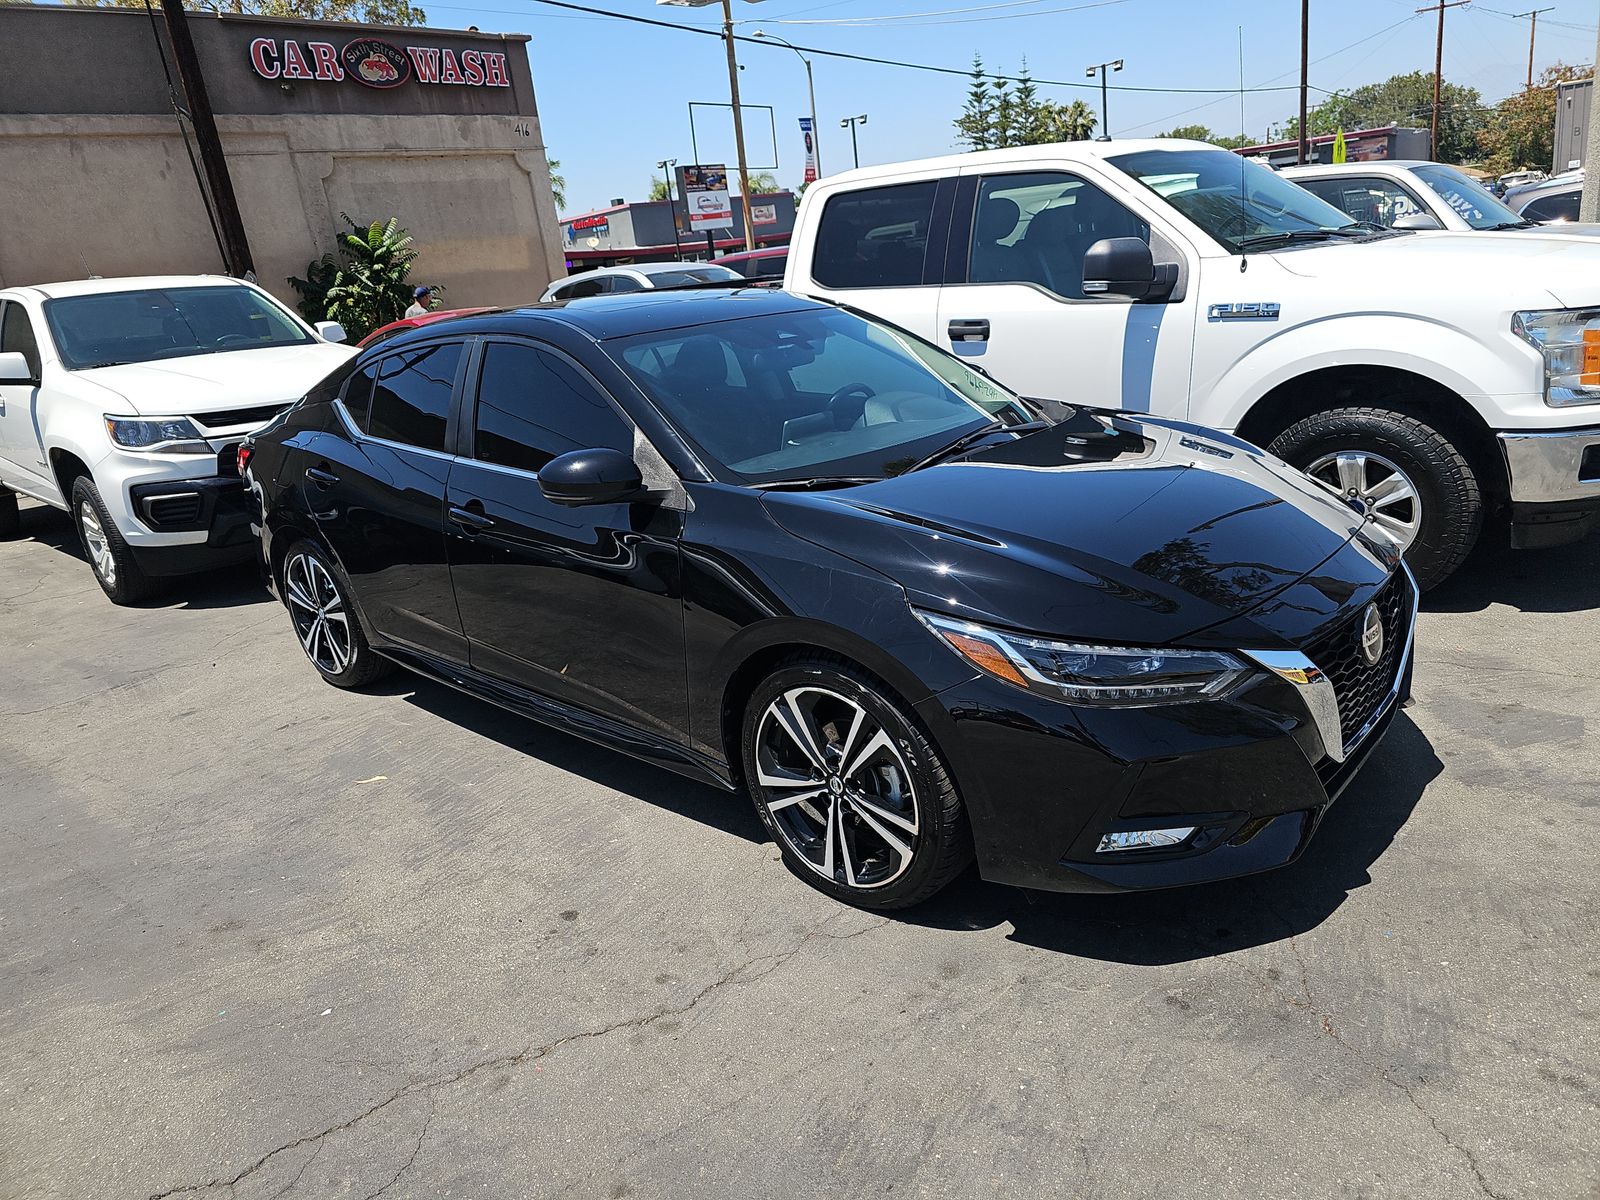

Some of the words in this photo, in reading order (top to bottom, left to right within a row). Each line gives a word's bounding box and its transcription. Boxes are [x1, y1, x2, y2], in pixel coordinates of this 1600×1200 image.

[250, 38, 344, 81] CAR
[407, 46, 510, 87] WASH
[346, 44, 370, 63] Sixth
[372, 42, 405, 65] Street
[514, 123, 530, 137] 416
